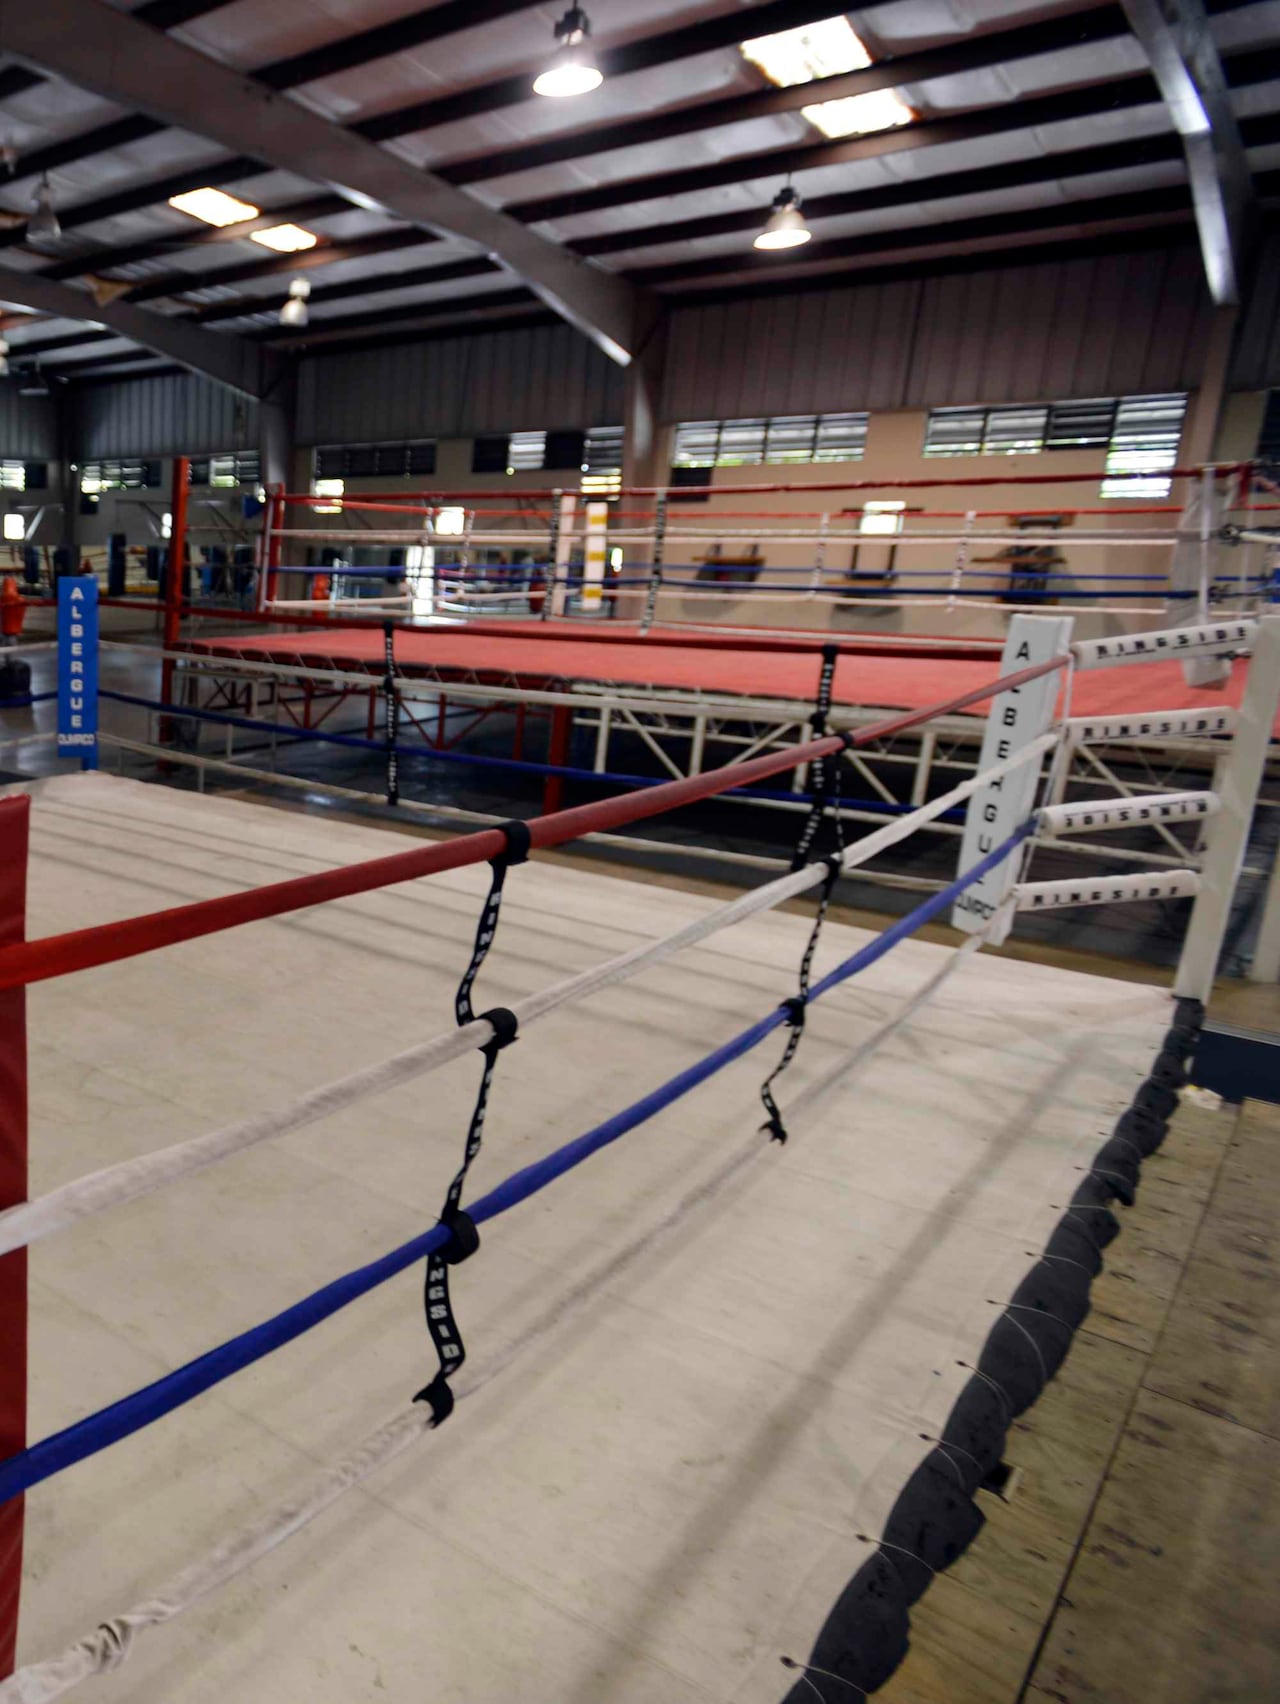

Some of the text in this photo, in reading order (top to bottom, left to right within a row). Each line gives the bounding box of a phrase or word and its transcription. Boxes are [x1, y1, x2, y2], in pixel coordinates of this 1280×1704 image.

[70, 587, 84, 728] ALBERGUE
[1096, 626, 1247, 658] RINGSIDE
[1081, 718, 1226, 740] RINGSIDE
